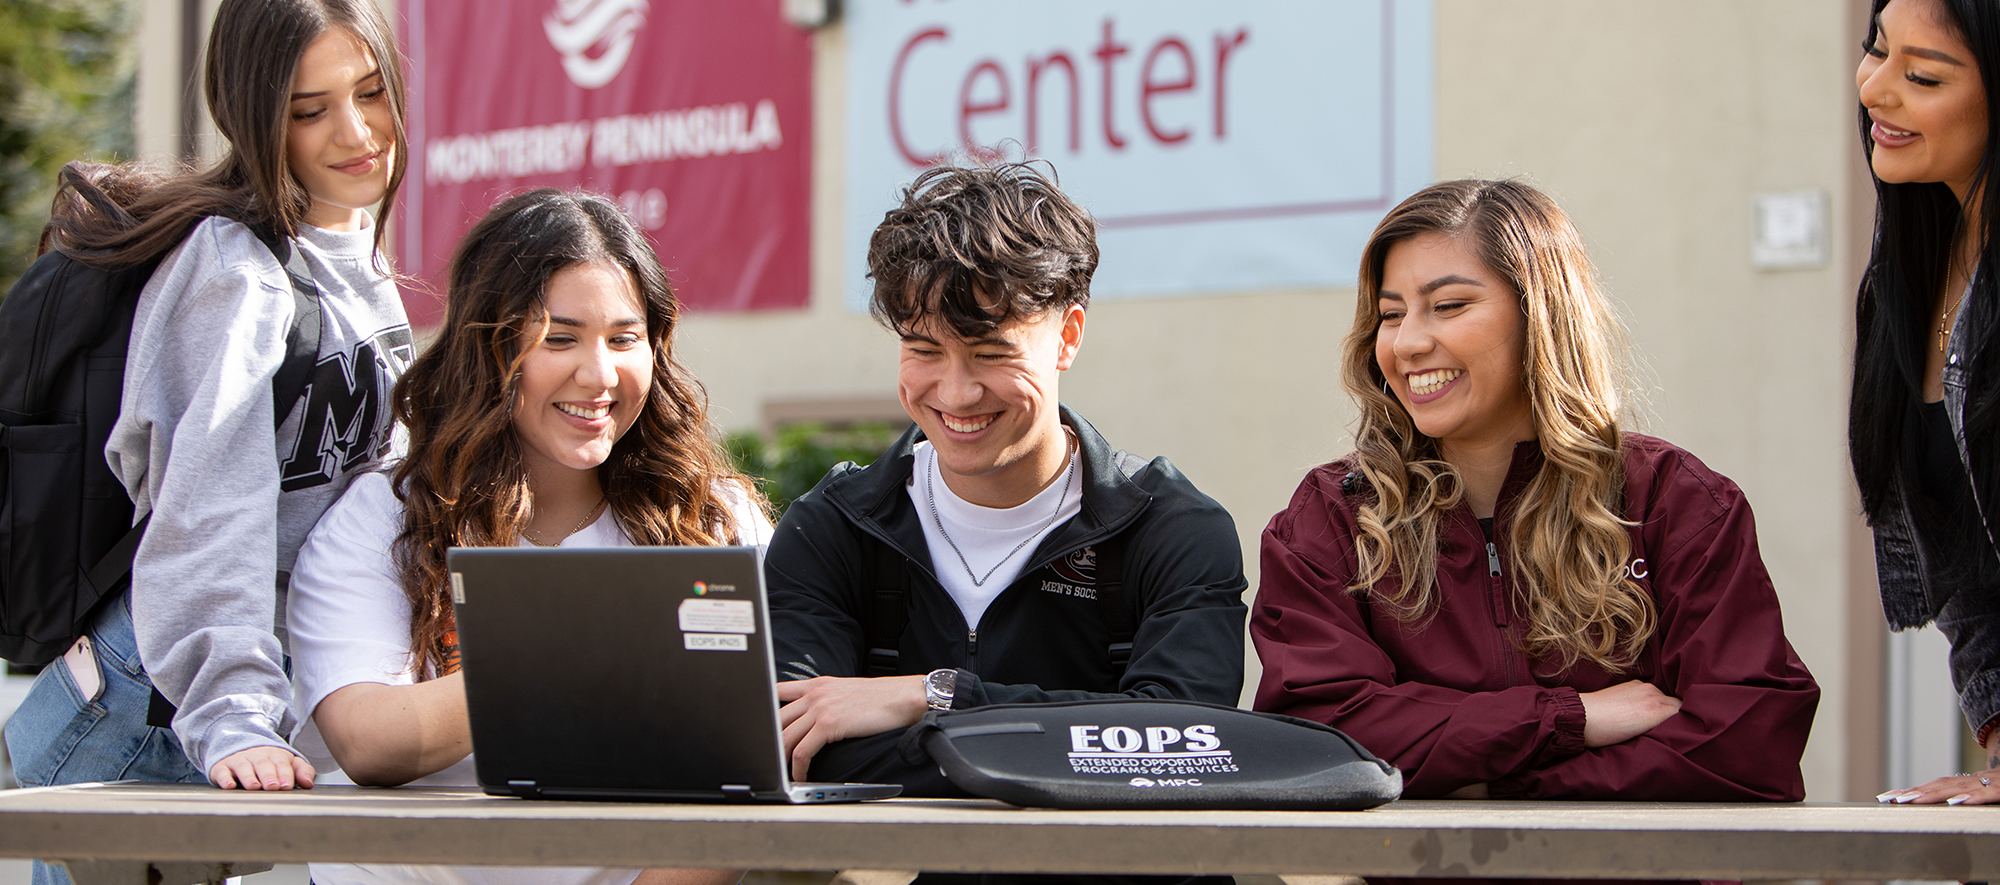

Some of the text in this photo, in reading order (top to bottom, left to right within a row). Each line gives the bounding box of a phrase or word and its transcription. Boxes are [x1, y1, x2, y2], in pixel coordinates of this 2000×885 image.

[886, 15, 1251, 169] Center
[426, 98, 783, 185] MONTEREY PENINSULA
[708, 584, 735, 592] chrome
[1041, 580, 1098, 600] MEN'S SOCC
[691, 637, 716, 647] EOPS
[1069, 725, 1221, 753] EOPS
[1069, 756, 1233, 767] EXTENDED OPPORTUNITY
[1073, 764, 1240, 775] PROGRAMS & SERVICES
[1157, 778, 1203, 787] MPC
